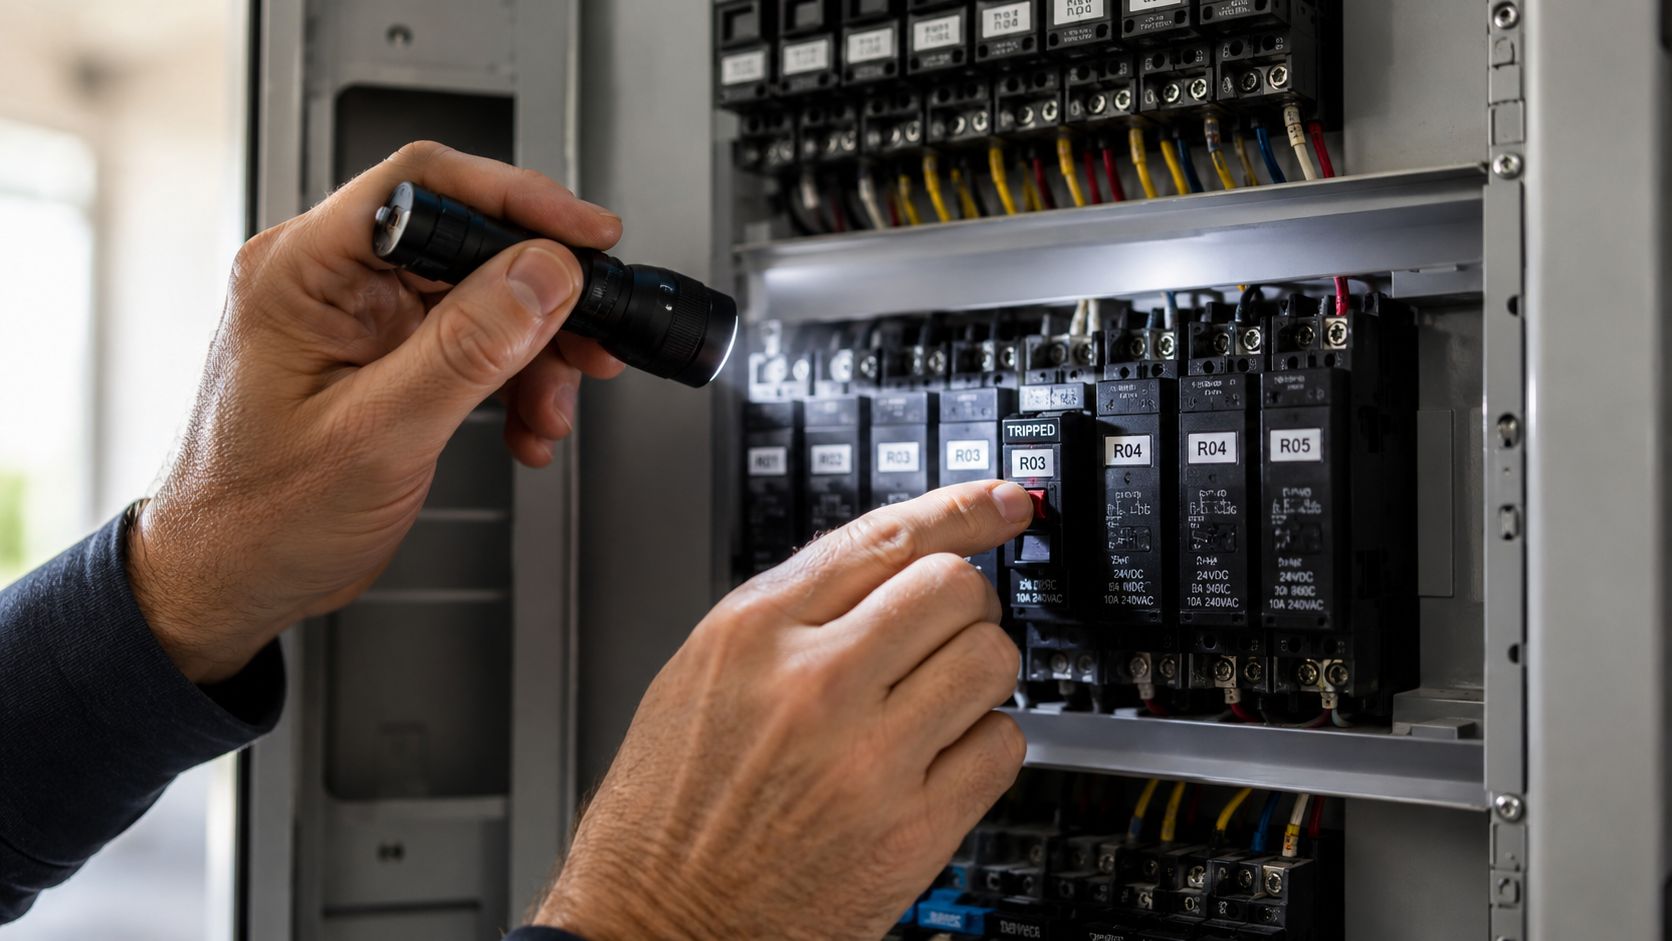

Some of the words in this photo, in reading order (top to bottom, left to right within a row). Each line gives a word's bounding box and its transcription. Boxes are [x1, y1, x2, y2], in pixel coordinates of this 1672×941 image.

[1007, 424, 1055, 437] TRIPPED
[1114, 443, 1142, 458] R04
[1198, 441, 1226, 456] R04
[1281, 438, 1311, 453] R05
[886, 451, 911, 464] R03
[955, 449, 981, 463] R03
[1020, 456, 1046, 470] R03
[1197, 570, 1229, 581] 24VDC
[1279, 571, 1314, 583] 24VDC
[1016, 592, 1031, 603] 10A
[1104, 594, 1119, 605] 10A
[1121, 595, 1154, 606] 240VAC
[1187, 596, 1202, 607] 10A
[1204, 597, 1239, 608] 240VAC
[1269, 599, 1285, 610] 10A
[1288, 600, 1324, 611] 240VAC
